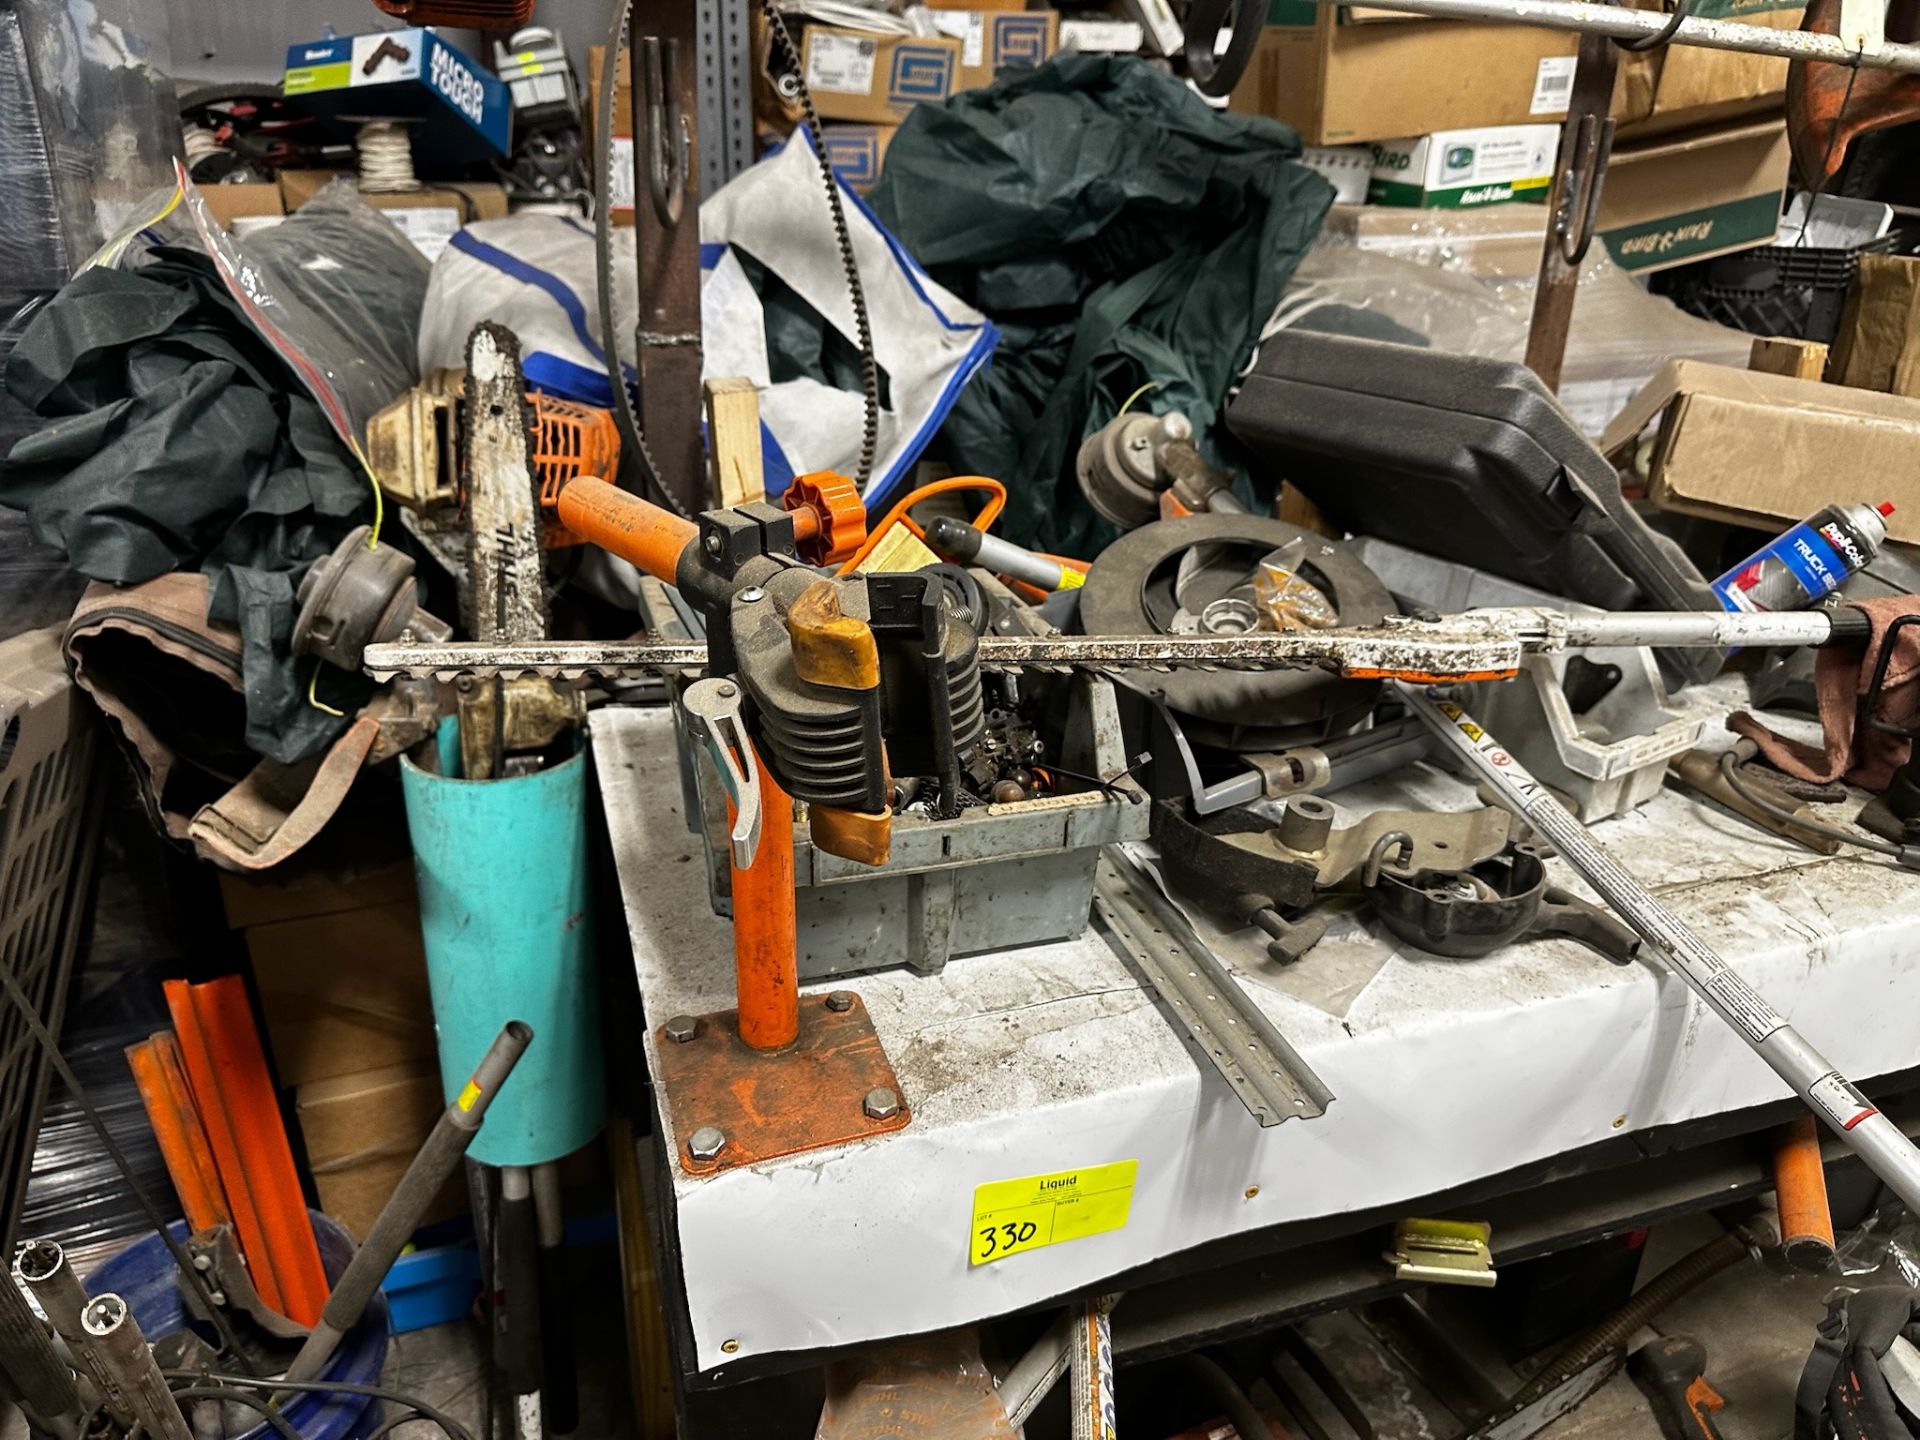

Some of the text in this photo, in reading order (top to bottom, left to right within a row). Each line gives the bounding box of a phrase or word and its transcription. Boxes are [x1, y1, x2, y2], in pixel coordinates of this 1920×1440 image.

[431, 42, 484, 101] MICRO
[430, 59, 483, 125] TOUCH
[495, 521, 519, 600] STIHL
[1793, 537, 1827, 575] TRUCK
[1040, 1175, 1078, 1192] Liquid
[976, 1214, 989, 1222] LOT
[979, 1222, 1037, 1258] 330
